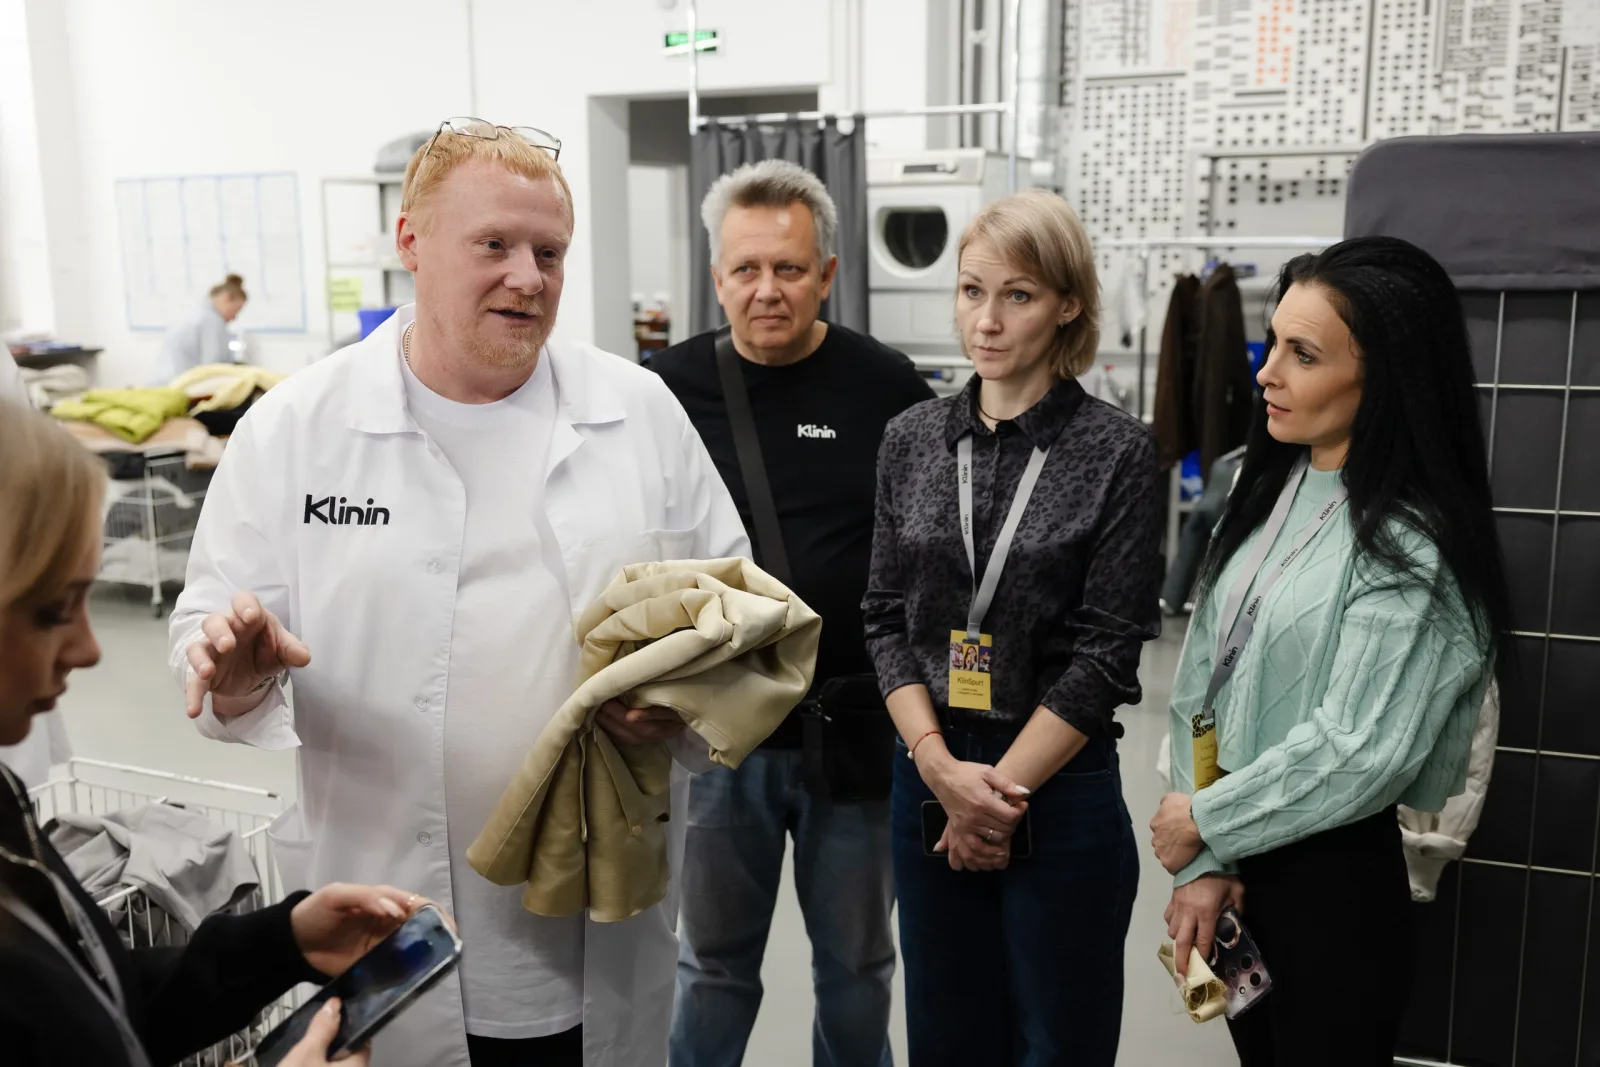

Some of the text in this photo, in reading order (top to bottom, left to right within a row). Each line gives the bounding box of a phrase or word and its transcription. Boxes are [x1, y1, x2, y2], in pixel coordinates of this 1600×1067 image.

[797, 424, 836, 439] Klinin
[303, 493, 390, 525] Klinin
[1319, 500, 1337, 521] Klinin
[1247, 595, 1261, 616] Klinin
[1222, 646, 1238, 667] Klinin
